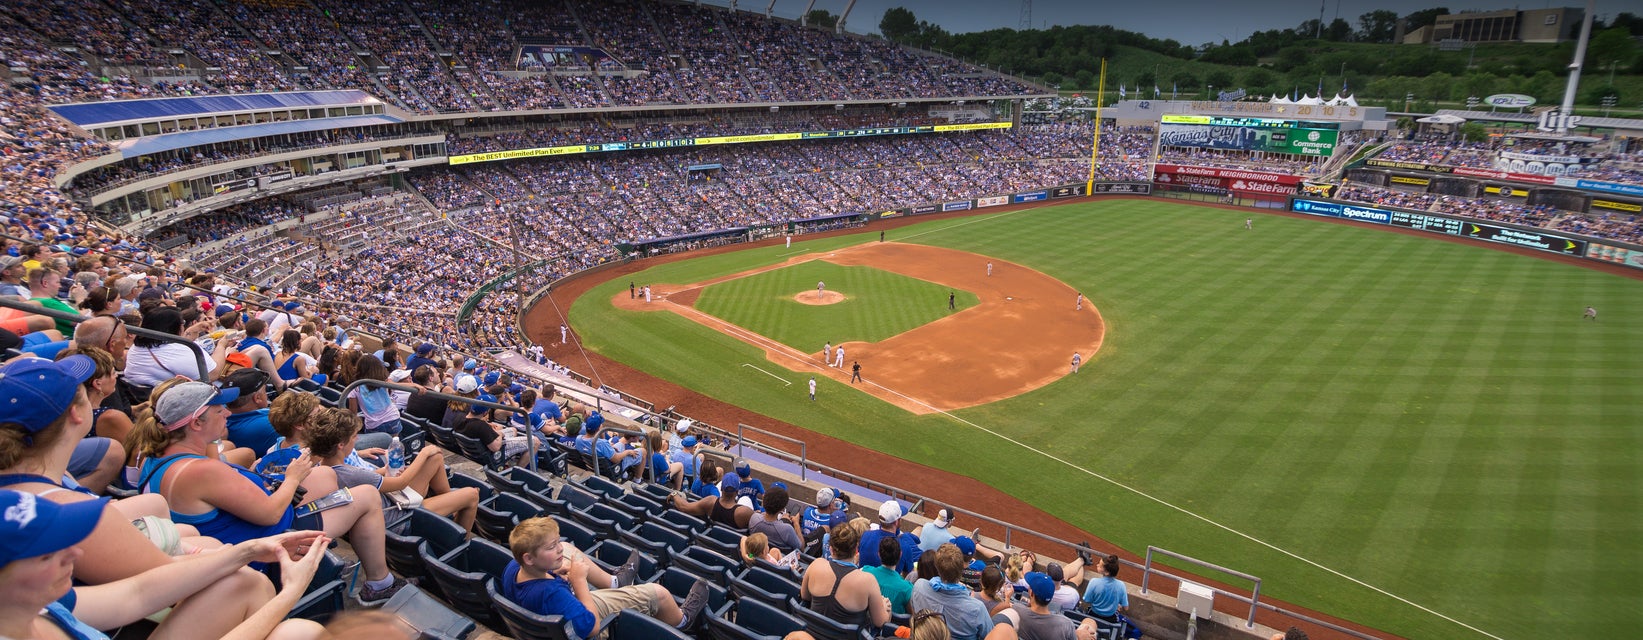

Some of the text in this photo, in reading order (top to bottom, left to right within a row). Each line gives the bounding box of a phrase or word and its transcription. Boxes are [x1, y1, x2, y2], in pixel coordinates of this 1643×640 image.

[1138, 101, 1150, 109] 42
[1297, 106, 1312, 115] 20
[1322, 106, 1334, 116] 10
[1349, 107, 1358, 117] 5
[1536, 110, 1584, 132] Lite
[1161, 125, 1237, 145] Kansas City
[1293, 139, 1332, 149] Commerce
[486, 153, 502, 161] BEST
[503, 150, 535, 159] Unlimited
[535, 149, 549, 157] Plan
[1302, 146, 1321, 155] Bank
[1218, 170, 1280, 182] NEIGHBORHOOD
[1311, 205, 1329, 213] Kansas
[1343, 207, 1388, 222] Spectrum
[1500, 228, 1542, 241] The Network
[1491, 234, 1507, 243] Built
[1517, 237, 1550, 249] Unlimited
